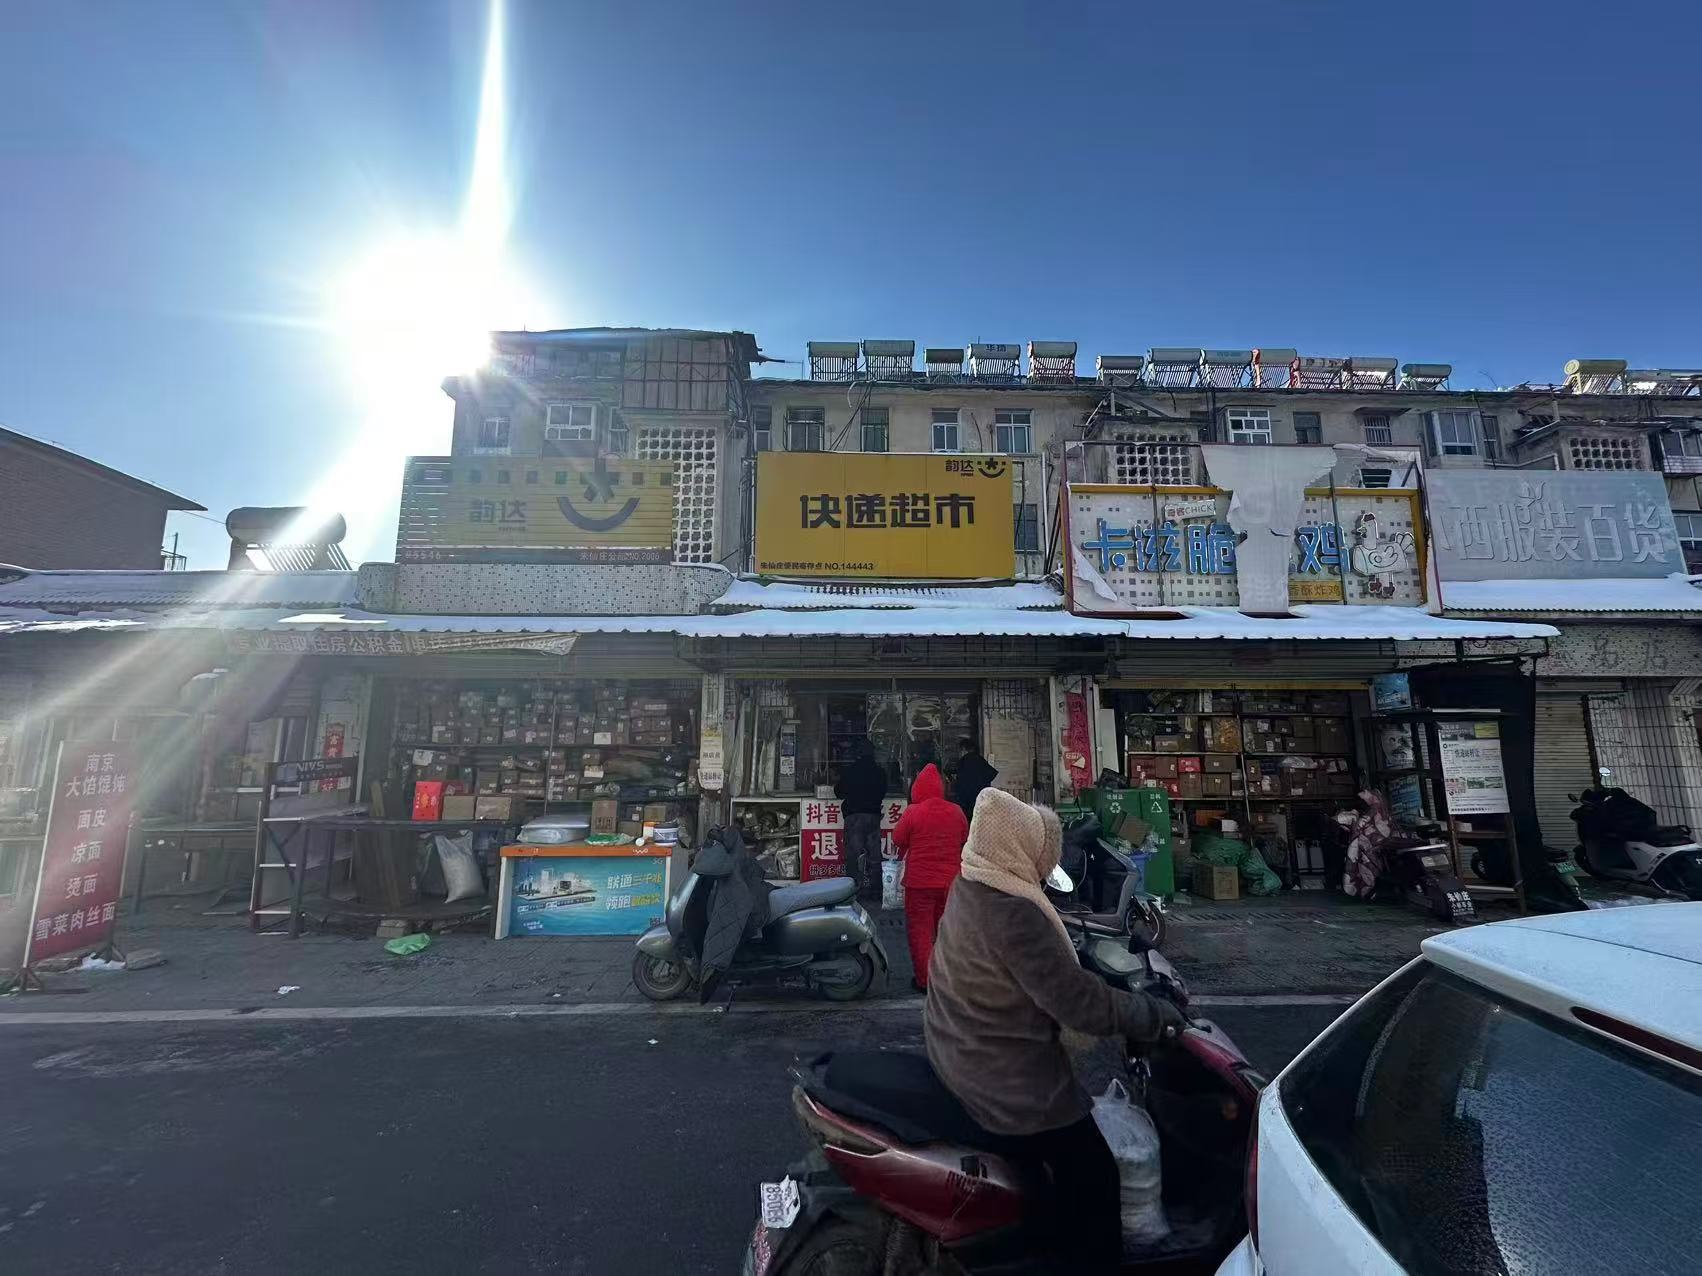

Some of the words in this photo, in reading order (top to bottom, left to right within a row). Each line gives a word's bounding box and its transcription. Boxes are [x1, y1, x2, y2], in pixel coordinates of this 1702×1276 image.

[945, 460, 974, 473] 韵达
[469, 500, 527, 524] 韵达
[799, 493, 976, 529] 快递超市
[1083, 519, 1351, 575] 卡滋脆鸡
[86, 752, 115, 773] 南京
[77, 809, 106, 831] 面皮
[806, 803, 841, 824] 抖音
[71, 840, 103, 864] 凉面
[35, 901, 117, 941] 雪菜肉丝面
